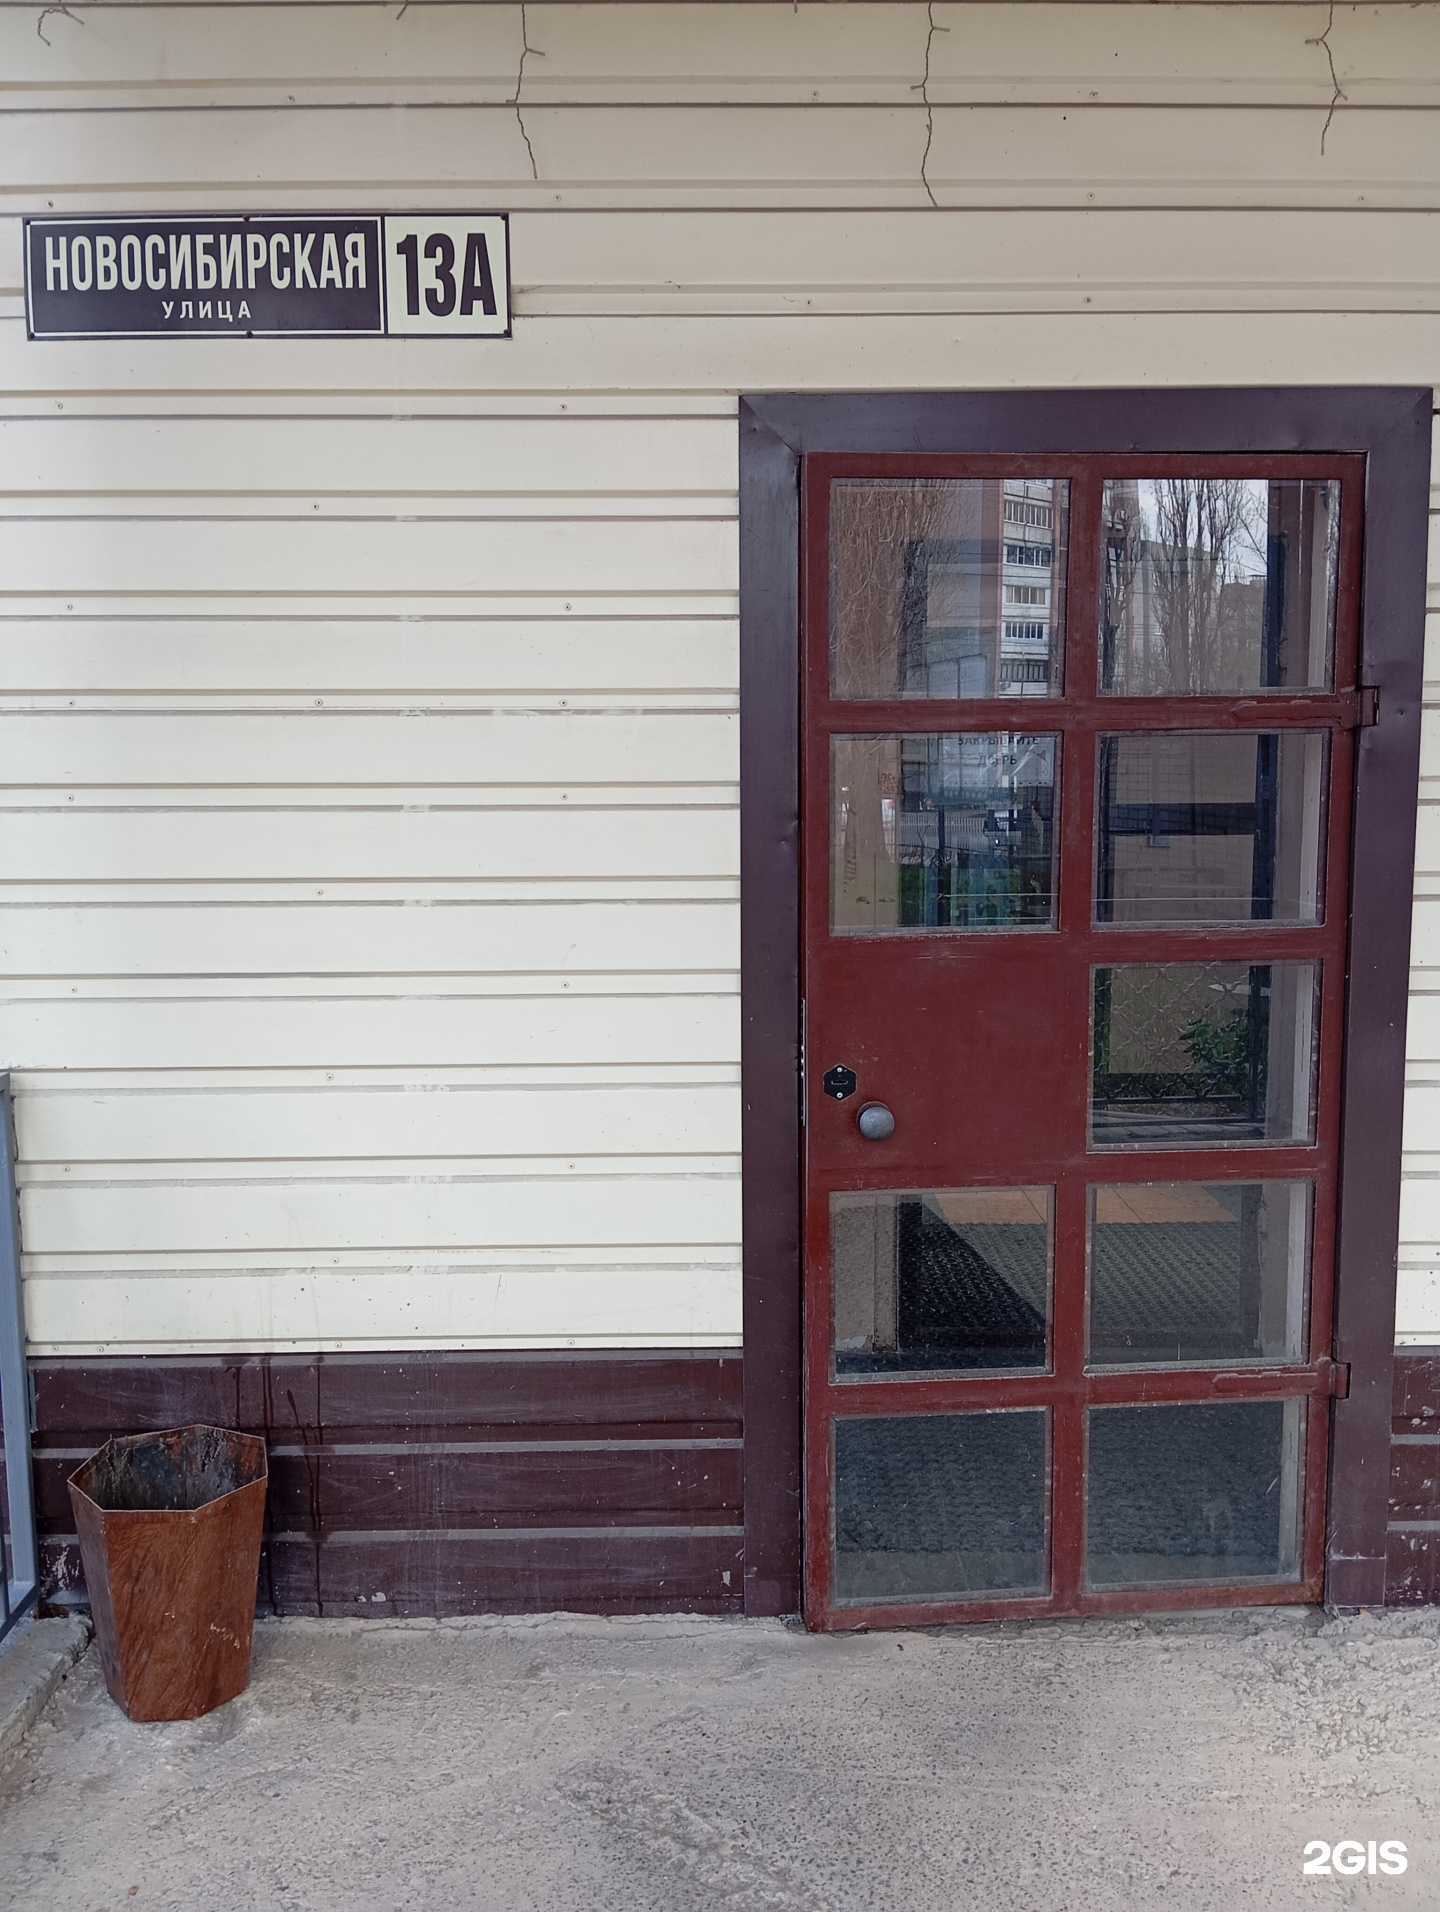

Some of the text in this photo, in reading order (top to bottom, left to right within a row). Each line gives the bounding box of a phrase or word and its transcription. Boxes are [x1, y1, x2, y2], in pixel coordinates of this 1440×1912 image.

[45, 232, 367, 291] НОВОСИБИРСКАЯ
[396, 232, 498, 317] 13А
[162, 300, 251, 322] УЛИЦА
[957, 735, 1040, 746] ЗАКРЫАЙТЕ
